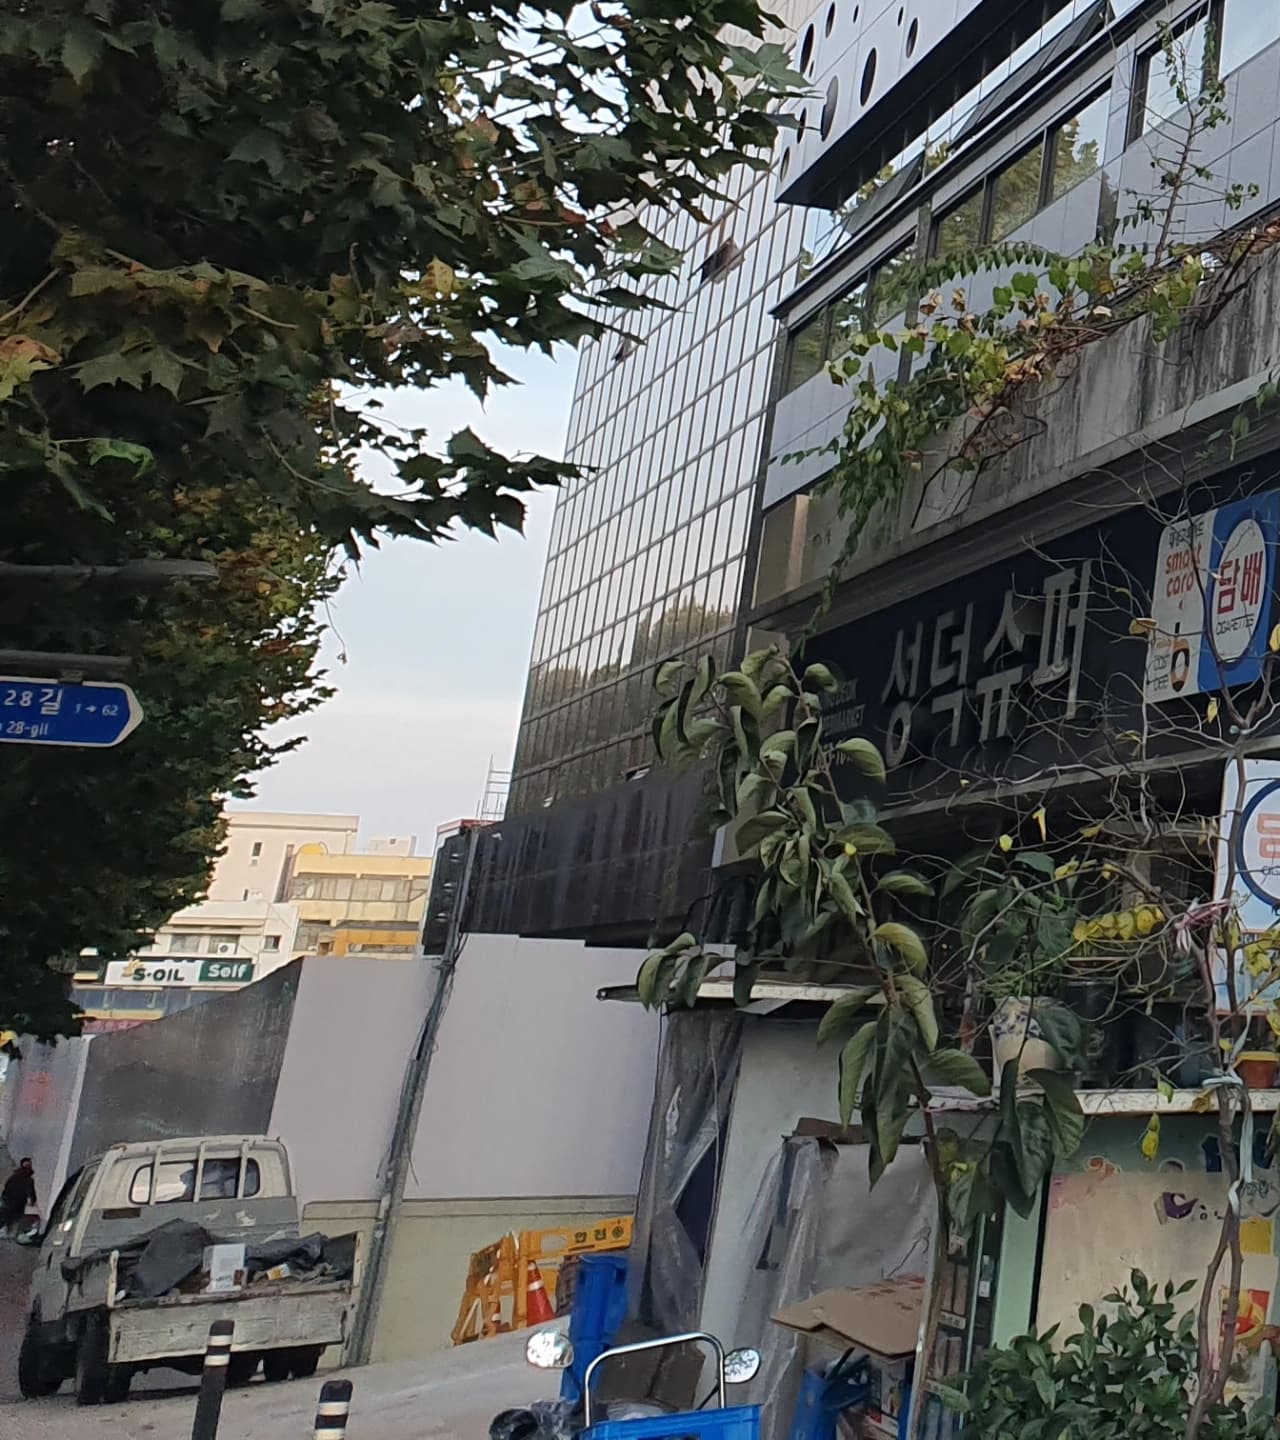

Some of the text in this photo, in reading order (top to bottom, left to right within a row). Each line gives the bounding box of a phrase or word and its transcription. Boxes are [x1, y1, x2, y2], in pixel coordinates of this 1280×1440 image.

[1165, 543, 1202, 575] smat
[1217, 550, 1264, 615] 담배
[881, 560, 1092, 768] 성덕슈퍼
[4, 688, 63, 715] 28길
[102, 705, 118, 716] 62
[6, 721, 48, 737] 28-gil
[132, 963, 246, 982] S-OIL Self
